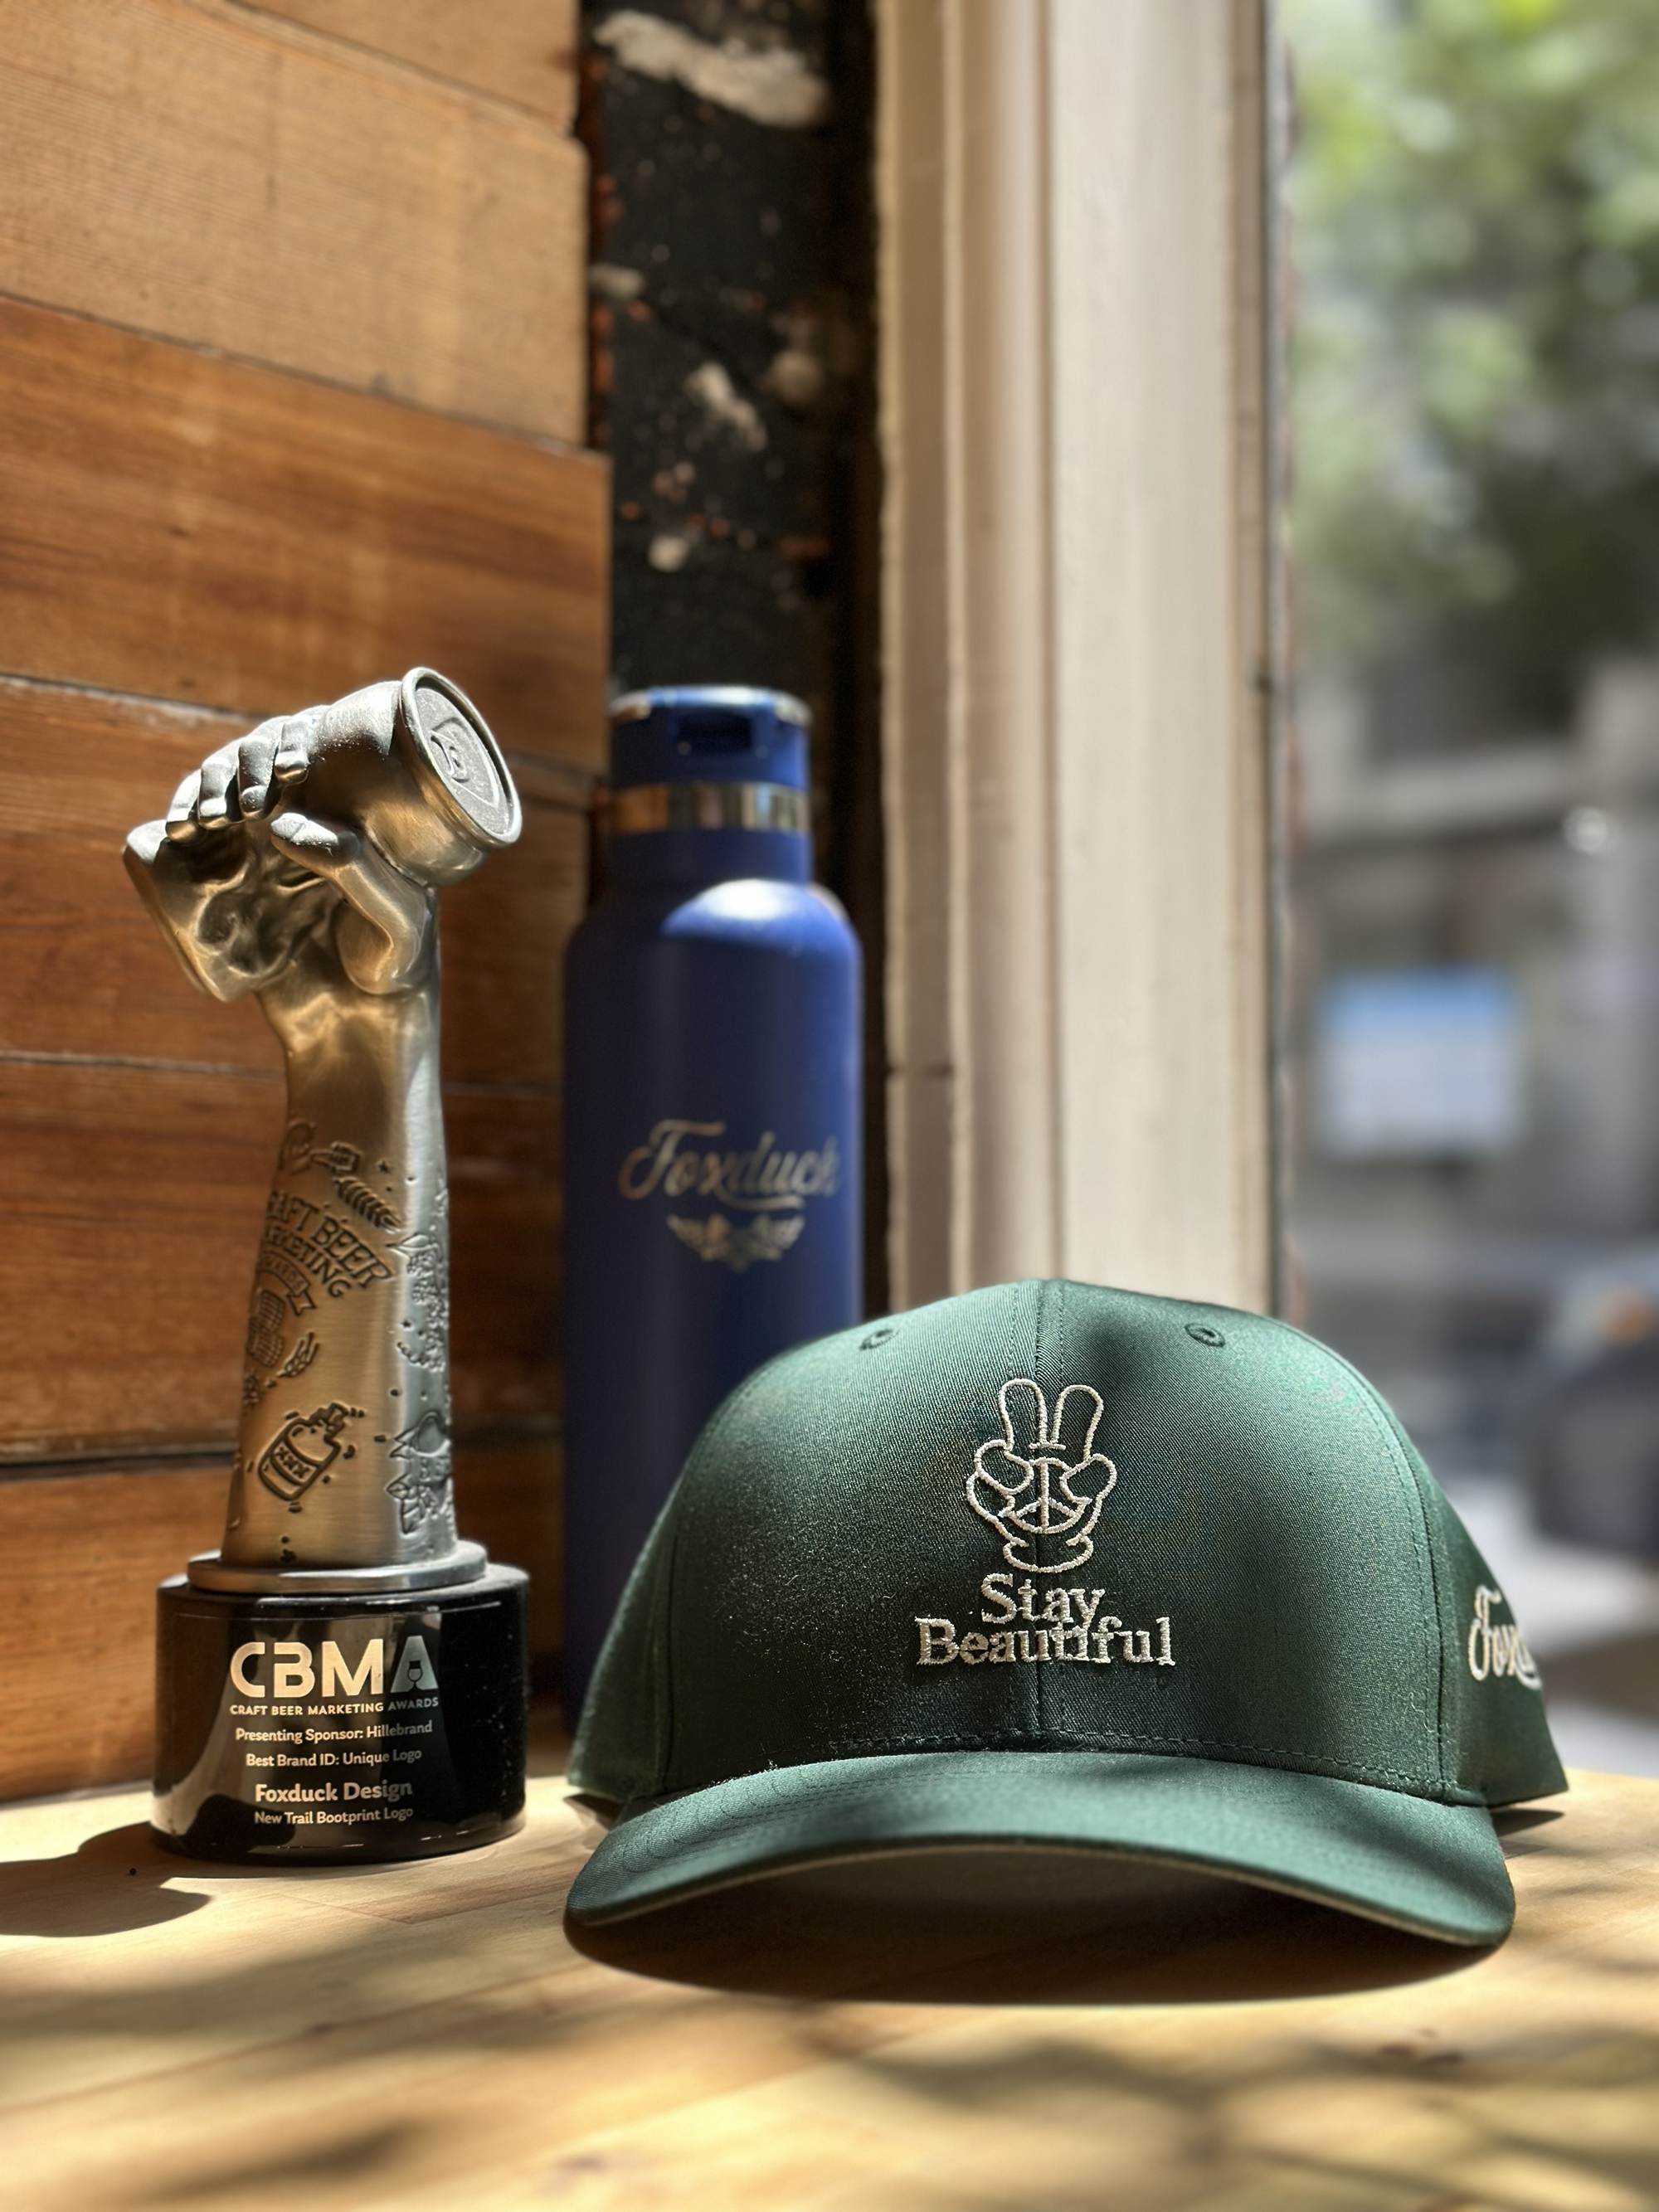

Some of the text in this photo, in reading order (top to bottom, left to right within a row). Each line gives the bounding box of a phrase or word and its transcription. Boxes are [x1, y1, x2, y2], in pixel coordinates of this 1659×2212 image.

[310, 1215, 392, 1290] BEER
[980, 1573, 1106, 1631] Stay
[914, 1614, 1176, 1666] Beautiful
[230, 1635, 439, 1699] CBMA
[229, 1696, 439, 1716] CRAFT BEER MARKETING AWARDS
[235, 1719, 433, 1745] Presenting Sponsor: Hillebrand
[246, 1748, 422, 1767] Best Brand ID: Unique Logo
[255, 1778, 413, 1802] Foxduck Design
[254, 1807, 414, 1826] New Trail Bootprint Logo
